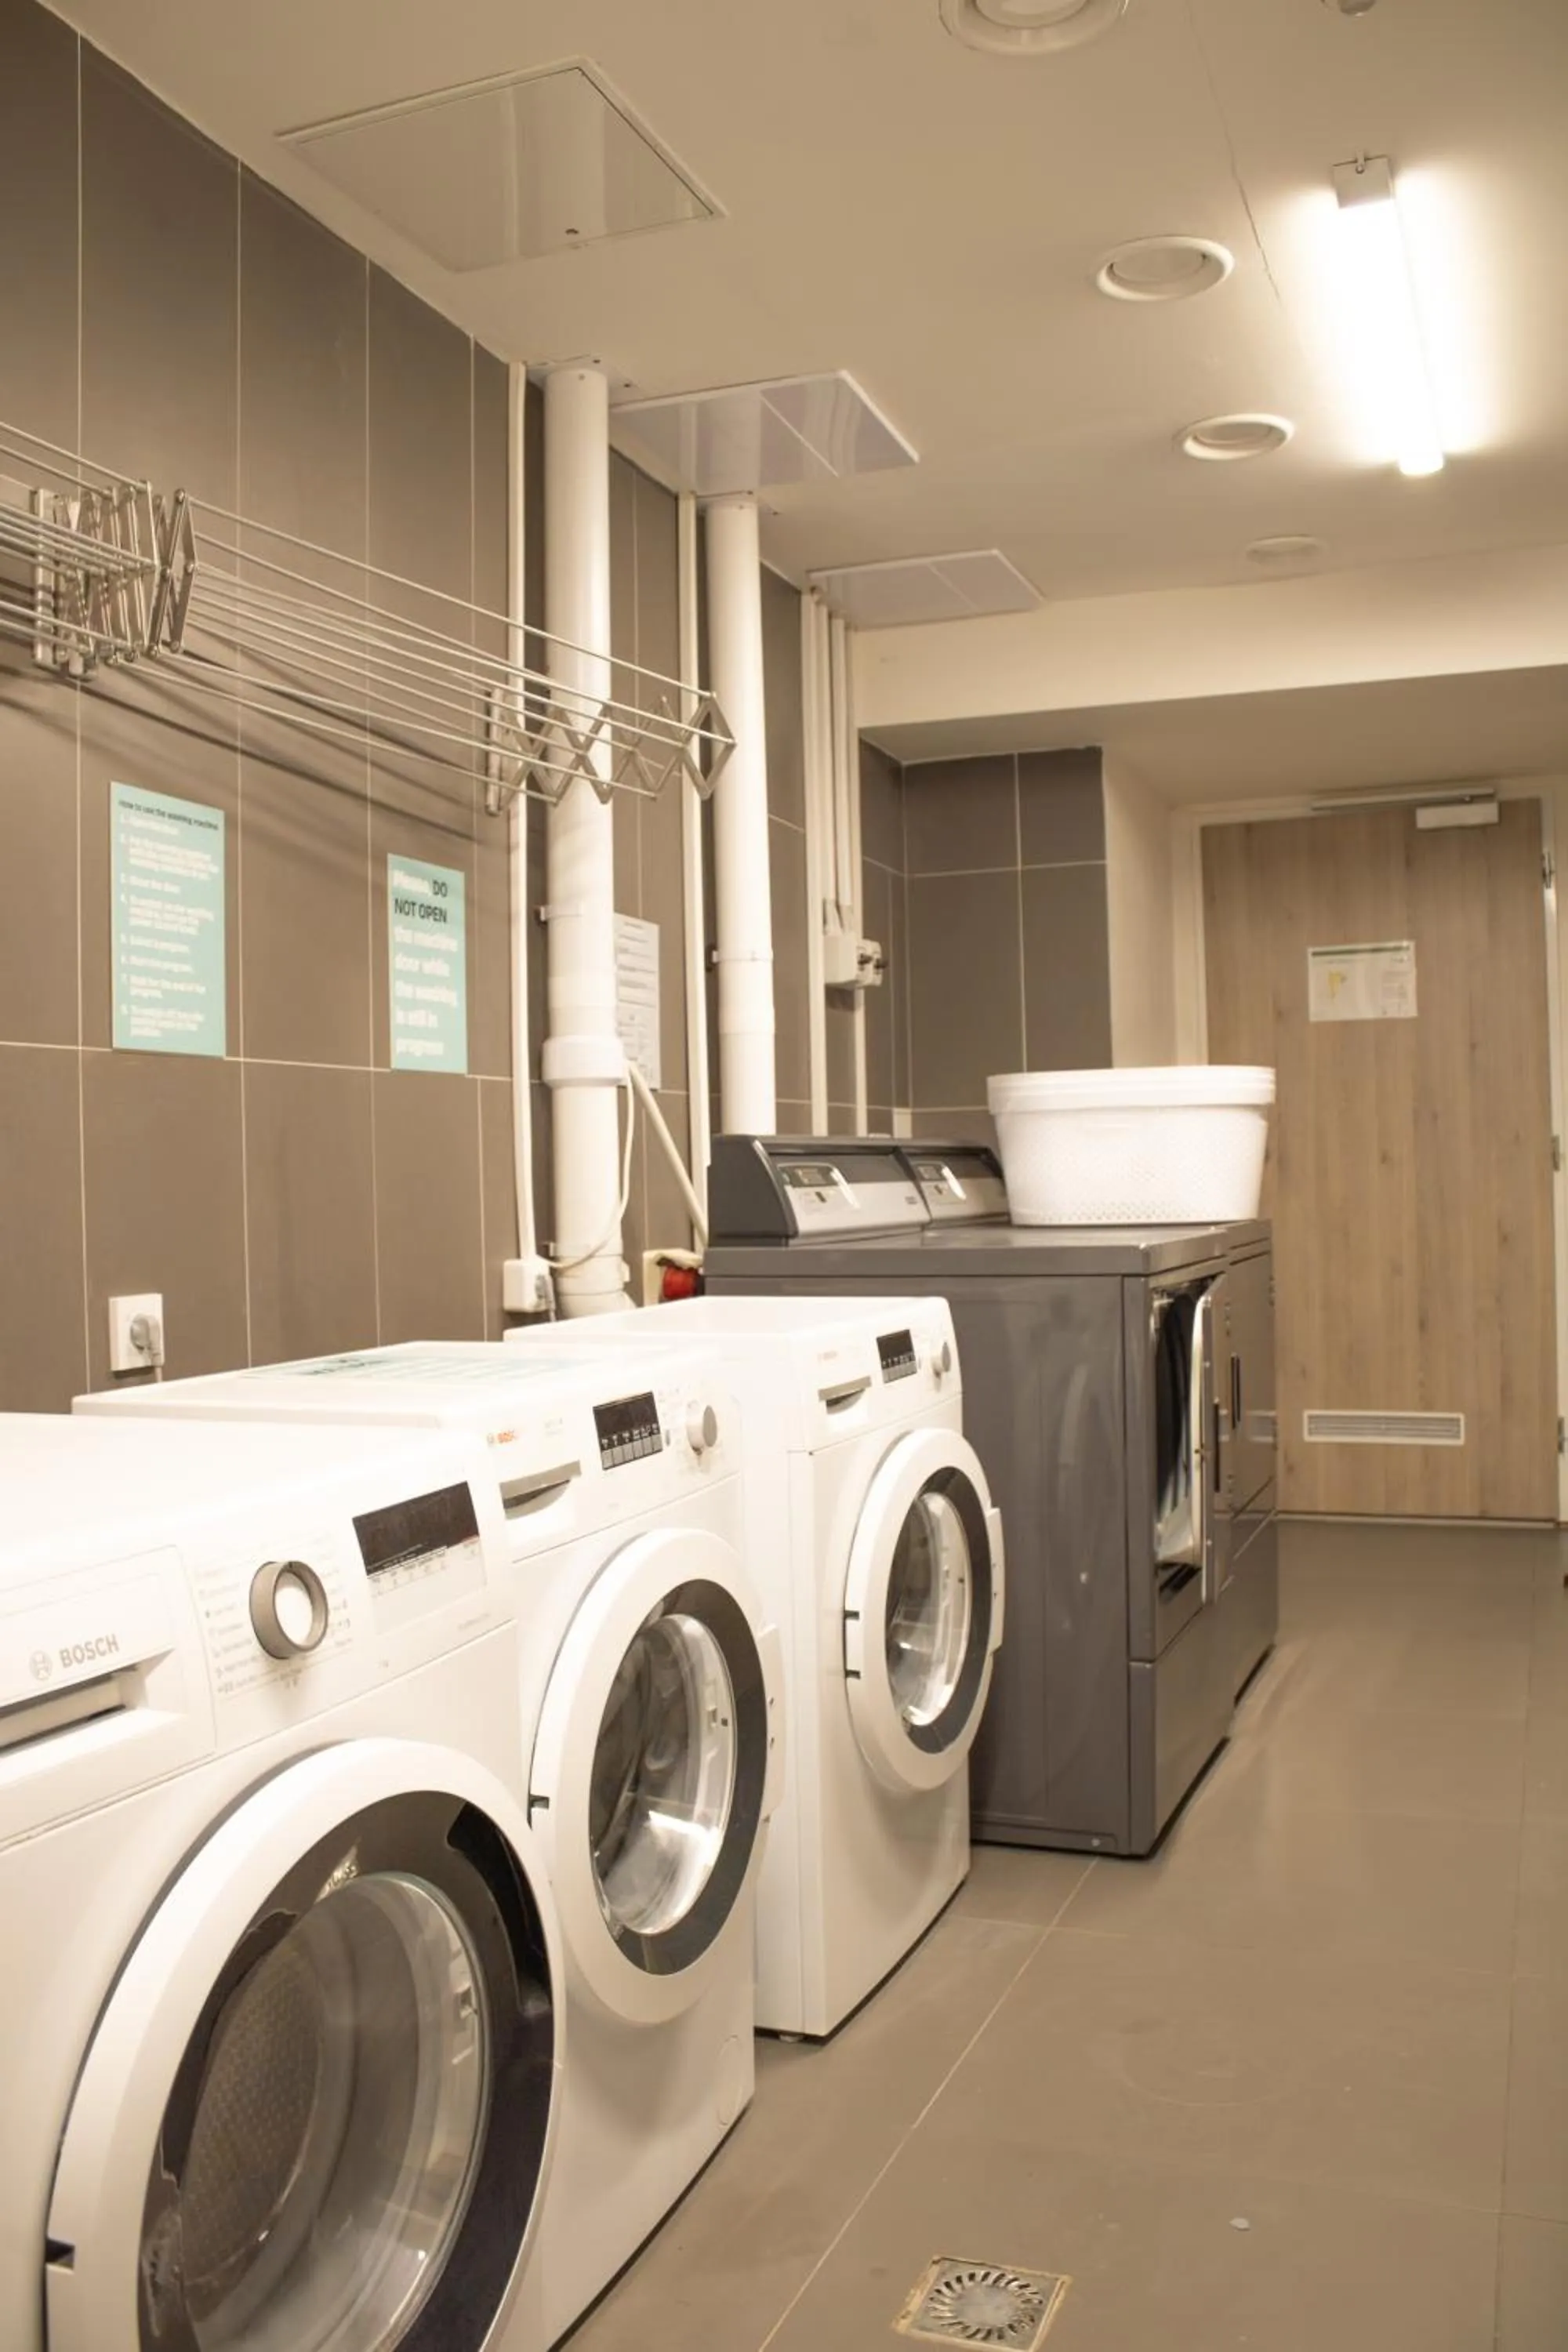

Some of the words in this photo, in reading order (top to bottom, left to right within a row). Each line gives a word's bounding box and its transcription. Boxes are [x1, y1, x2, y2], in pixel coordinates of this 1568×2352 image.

[432, 879, 448, 898] DO
[394, 898, 417, 916] NOT
[418, 903, 448, 924] OPEN
[59, 1633, 120, 1668] BOSCH
